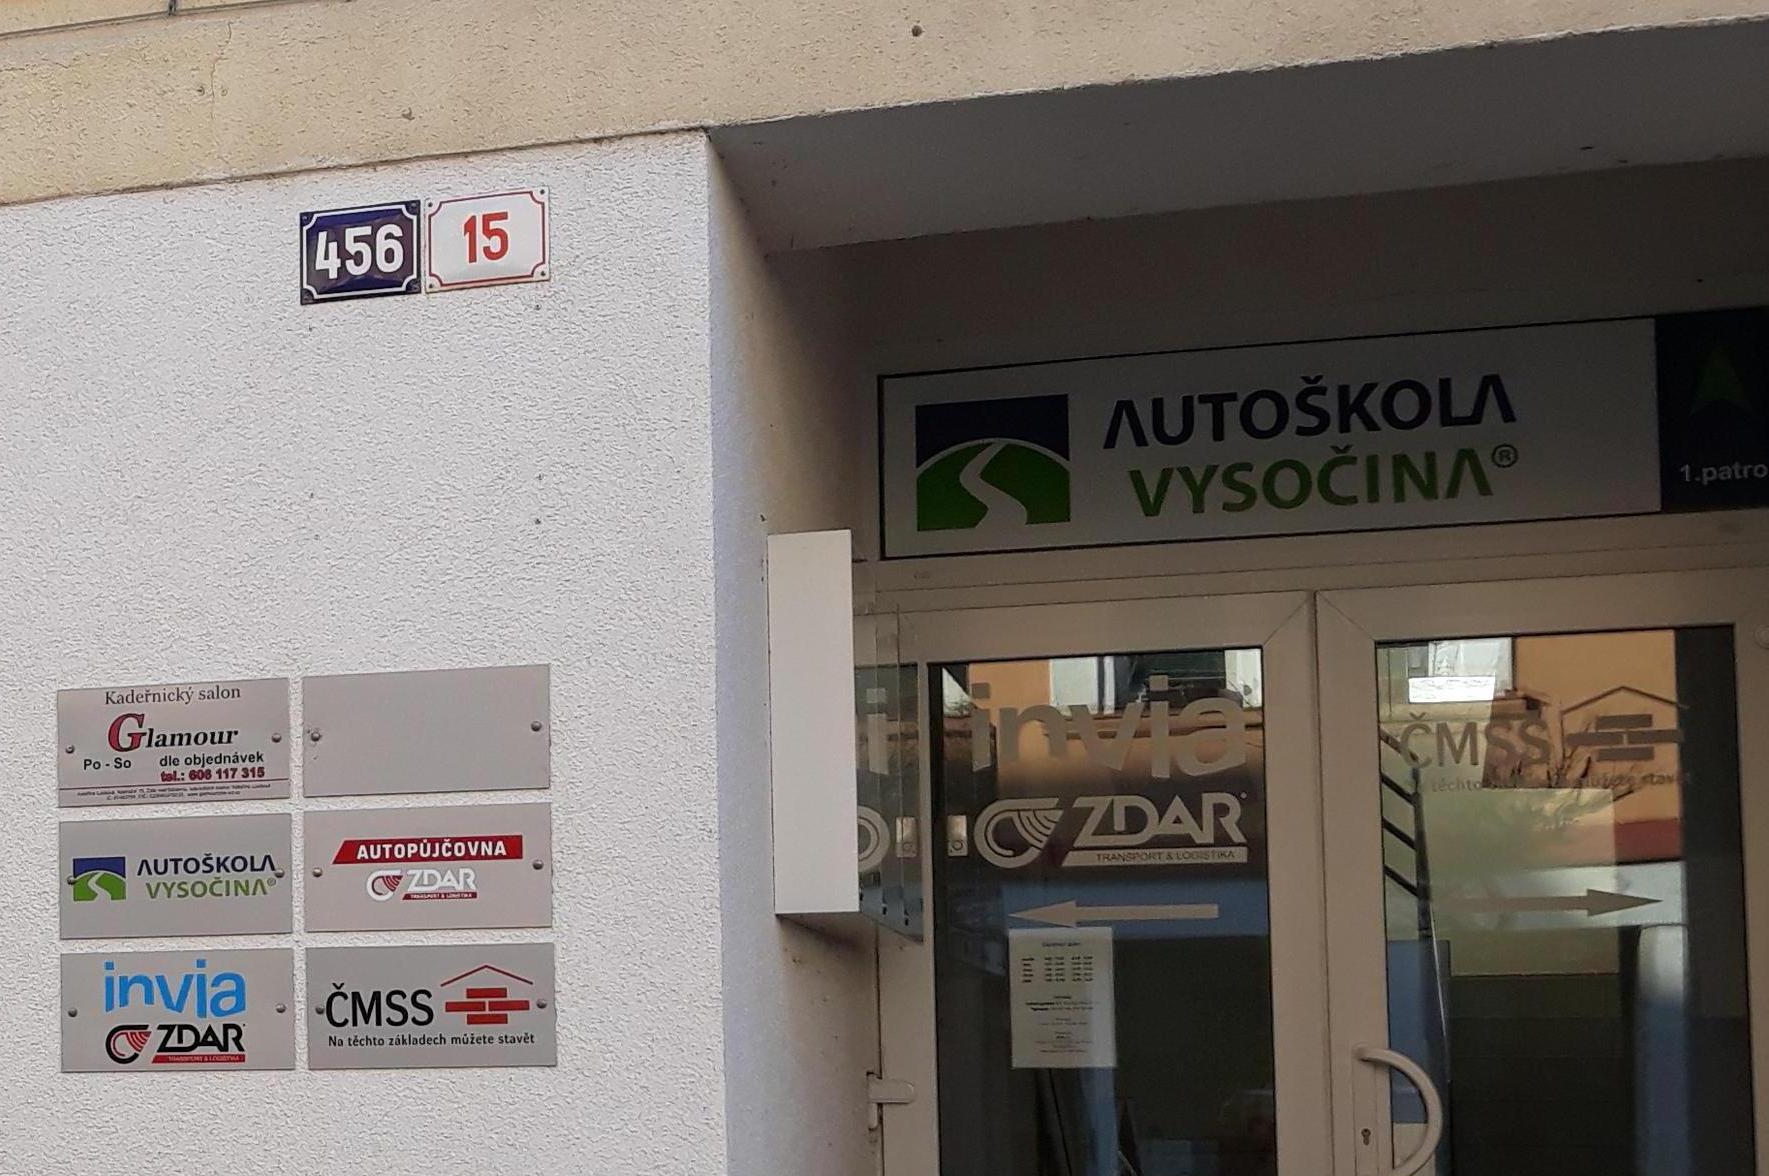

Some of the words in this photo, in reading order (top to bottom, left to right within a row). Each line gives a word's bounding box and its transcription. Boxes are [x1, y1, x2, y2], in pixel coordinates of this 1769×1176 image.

[315, 223, 405, 280] 456
[463, 211, 509, 264] 15
[1103, 374, 1518, 449] AUTOŠKOLA
[105, 686, 194, 705] Kadeřnický
[198, 684, 241, 701] salon
[108, 713, 239, 752] Glamour
[971, 674, 1247, 778] invia
[1400, 711, 1550, 769] ČMSS
[83, 758, 101, 770] Po
[114, 757, 132, 769] So
[160, 755, 180, 767] dle
[184, 751, 264, 768] objednávek
[216, 768, 238, 779] 117
[241, 766, 265, 778] 315
[1073, 792, 1247, 847] ZDAR
[356, 838, 507, 860] AUTOPŮJČOVNA
[1096, 851, 1162, 863] TRANSPORT
[1176, 849, 1235, 861] LOGISTIKA
[137, 853, 276, 876] AUTOŠKOLA
[407, 867, 478, 891] ZDAR
[104, 959, 247, 1019] invia
[325, 982, 434, 1028] ČMSS
[157, 1023, 246, 1052] ZDAR
[328, 1035, 344, 1047] Na
[347, 1034, 385, 1047] těchto
[388, 1033, 446, 1046] základech
[451, 1033, 494, 1045] můžete
[498, 1033, 535, 1045] stavět
